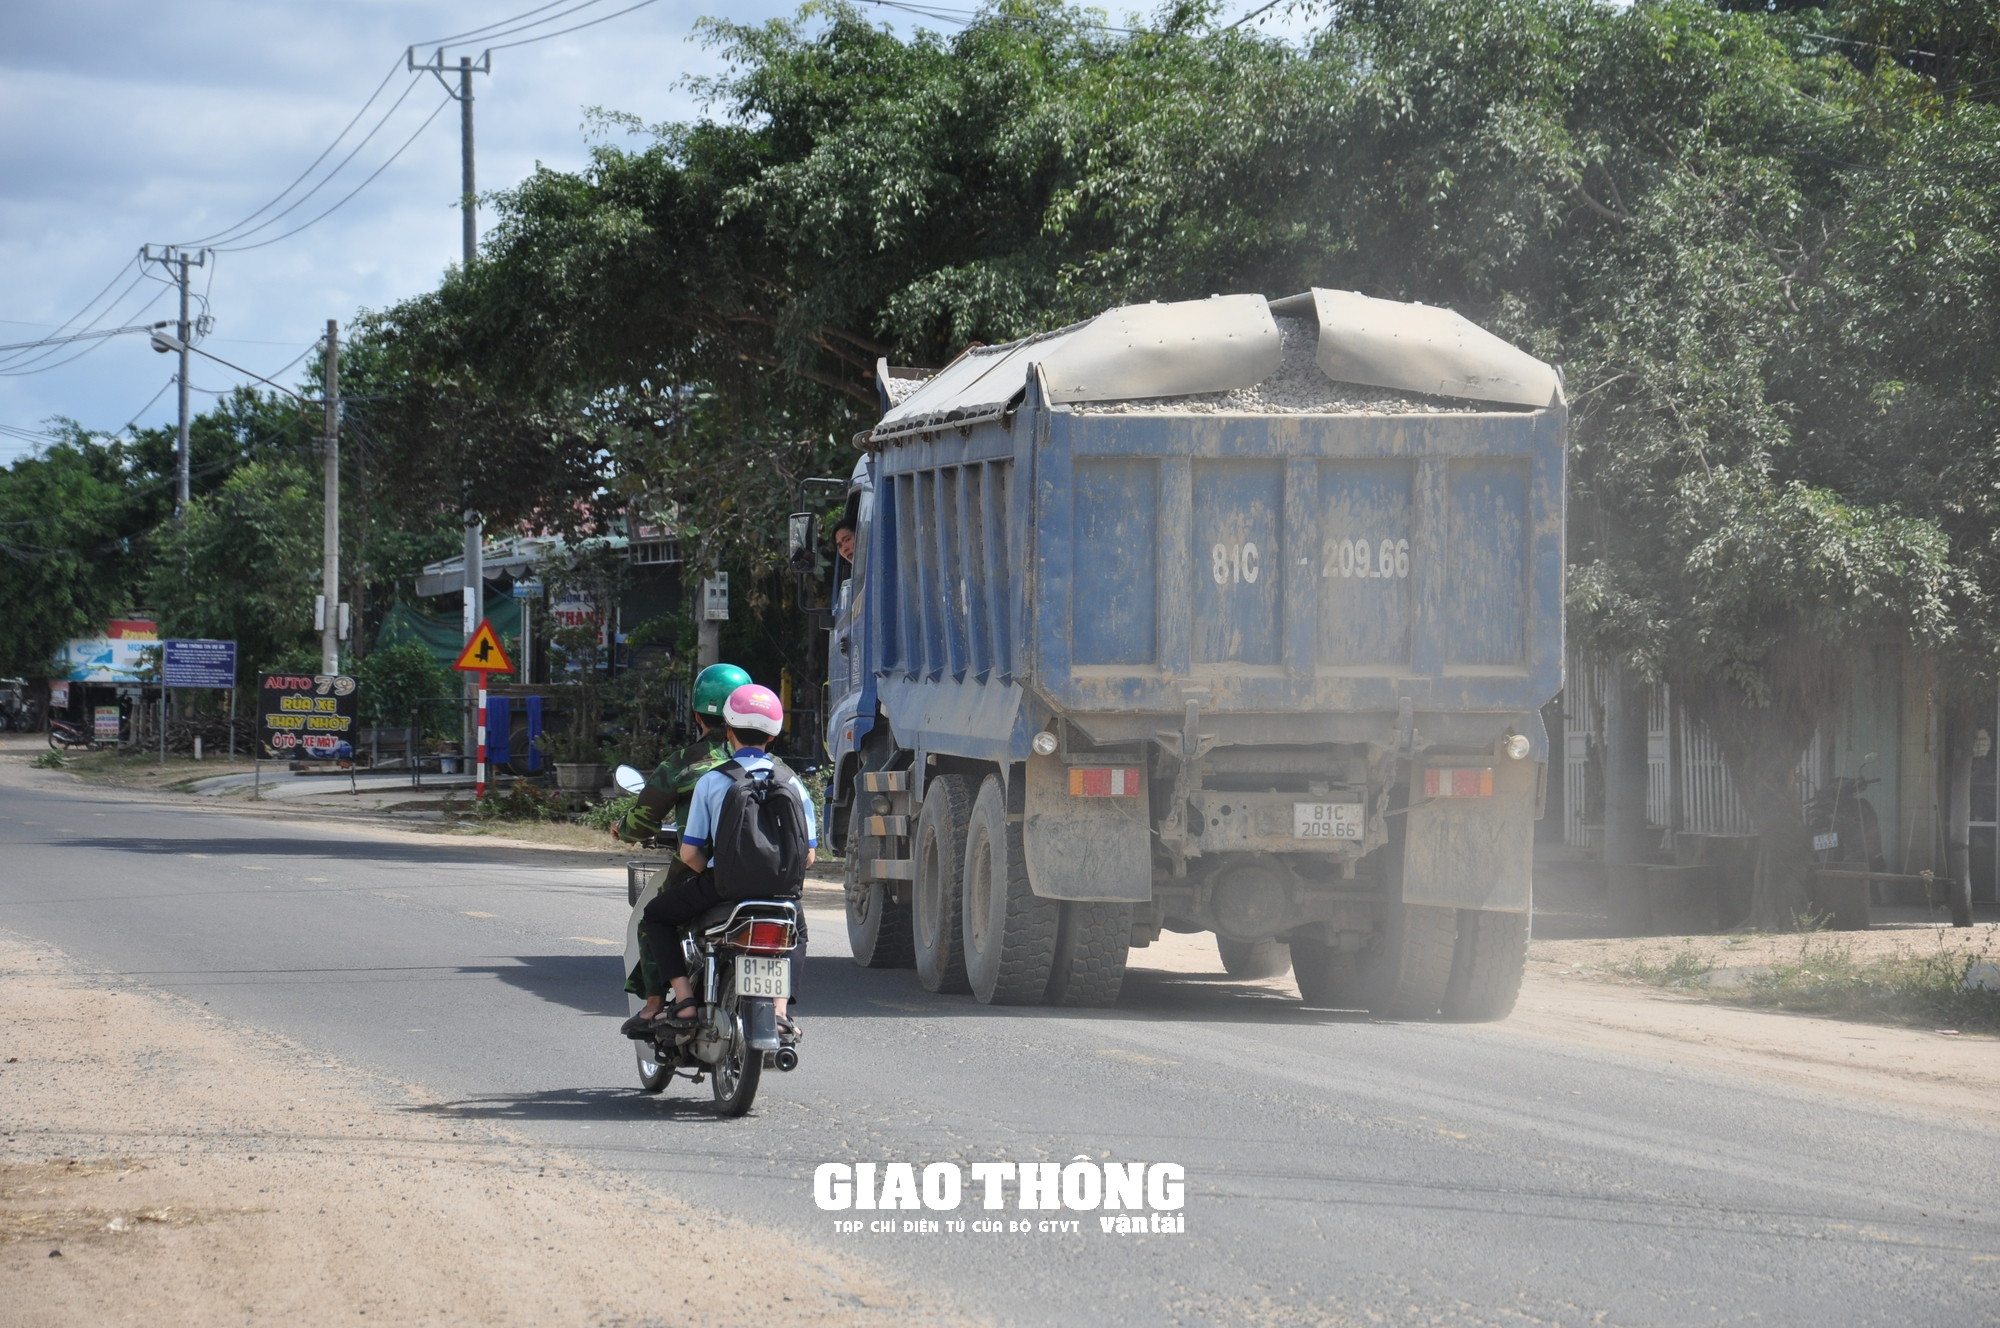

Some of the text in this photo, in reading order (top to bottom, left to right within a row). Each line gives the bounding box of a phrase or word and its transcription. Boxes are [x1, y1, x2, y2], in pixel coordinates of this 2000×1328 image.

[1212, 542, 1259, 584] 81C
[264, 675, 356, 696] AUTO 79
[281, 693, 337, 712] RỬA XE
[267, 713, 351, 731] THAY NHỚT
[272, 732, 282, 747] Ô
[283, 733, 296, 748] TÔ
[303, 735, 315, 748] XE
[315, 734, 338, 748] MÁY
[1314, 805, 1344, 820] 81C
[1301, 822, 1356, 837] 209.66
[744, 958, 782, 977] 81-H5
[743, 976, 782, 995] 0598
